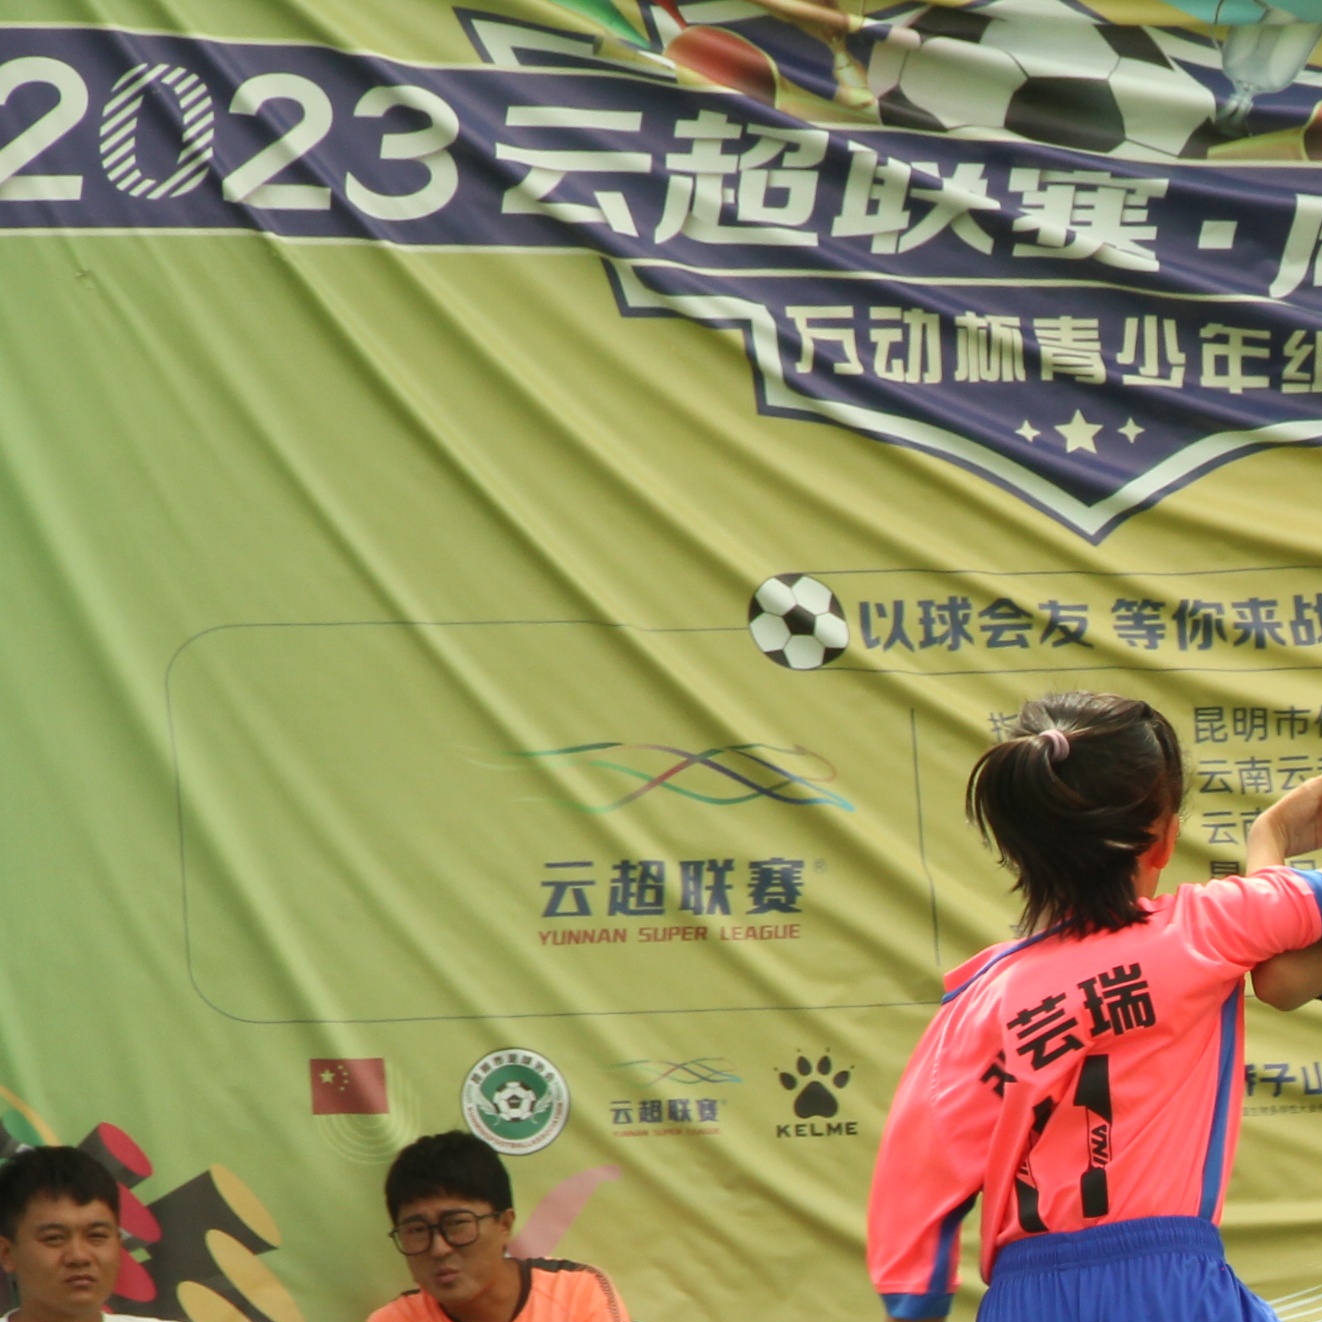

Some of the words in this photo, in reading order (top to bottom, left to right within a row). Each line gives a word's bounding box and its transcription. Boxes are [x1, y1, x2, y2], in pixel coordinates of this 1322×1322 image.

[0, 56, 460, 221] 2023
[858, 594, 1095, 653] 以球会友
[540, 857, 805, 919] 云超联赛
[538, 927, 627, 946] YUNNAN
[637, 925, 708, 943] SUPER
[719, 923, 801, 942] LEAGUE
[609, 1097, 720, 1125] 云超联赛
[776, 1122, 859, 1138] KELME
